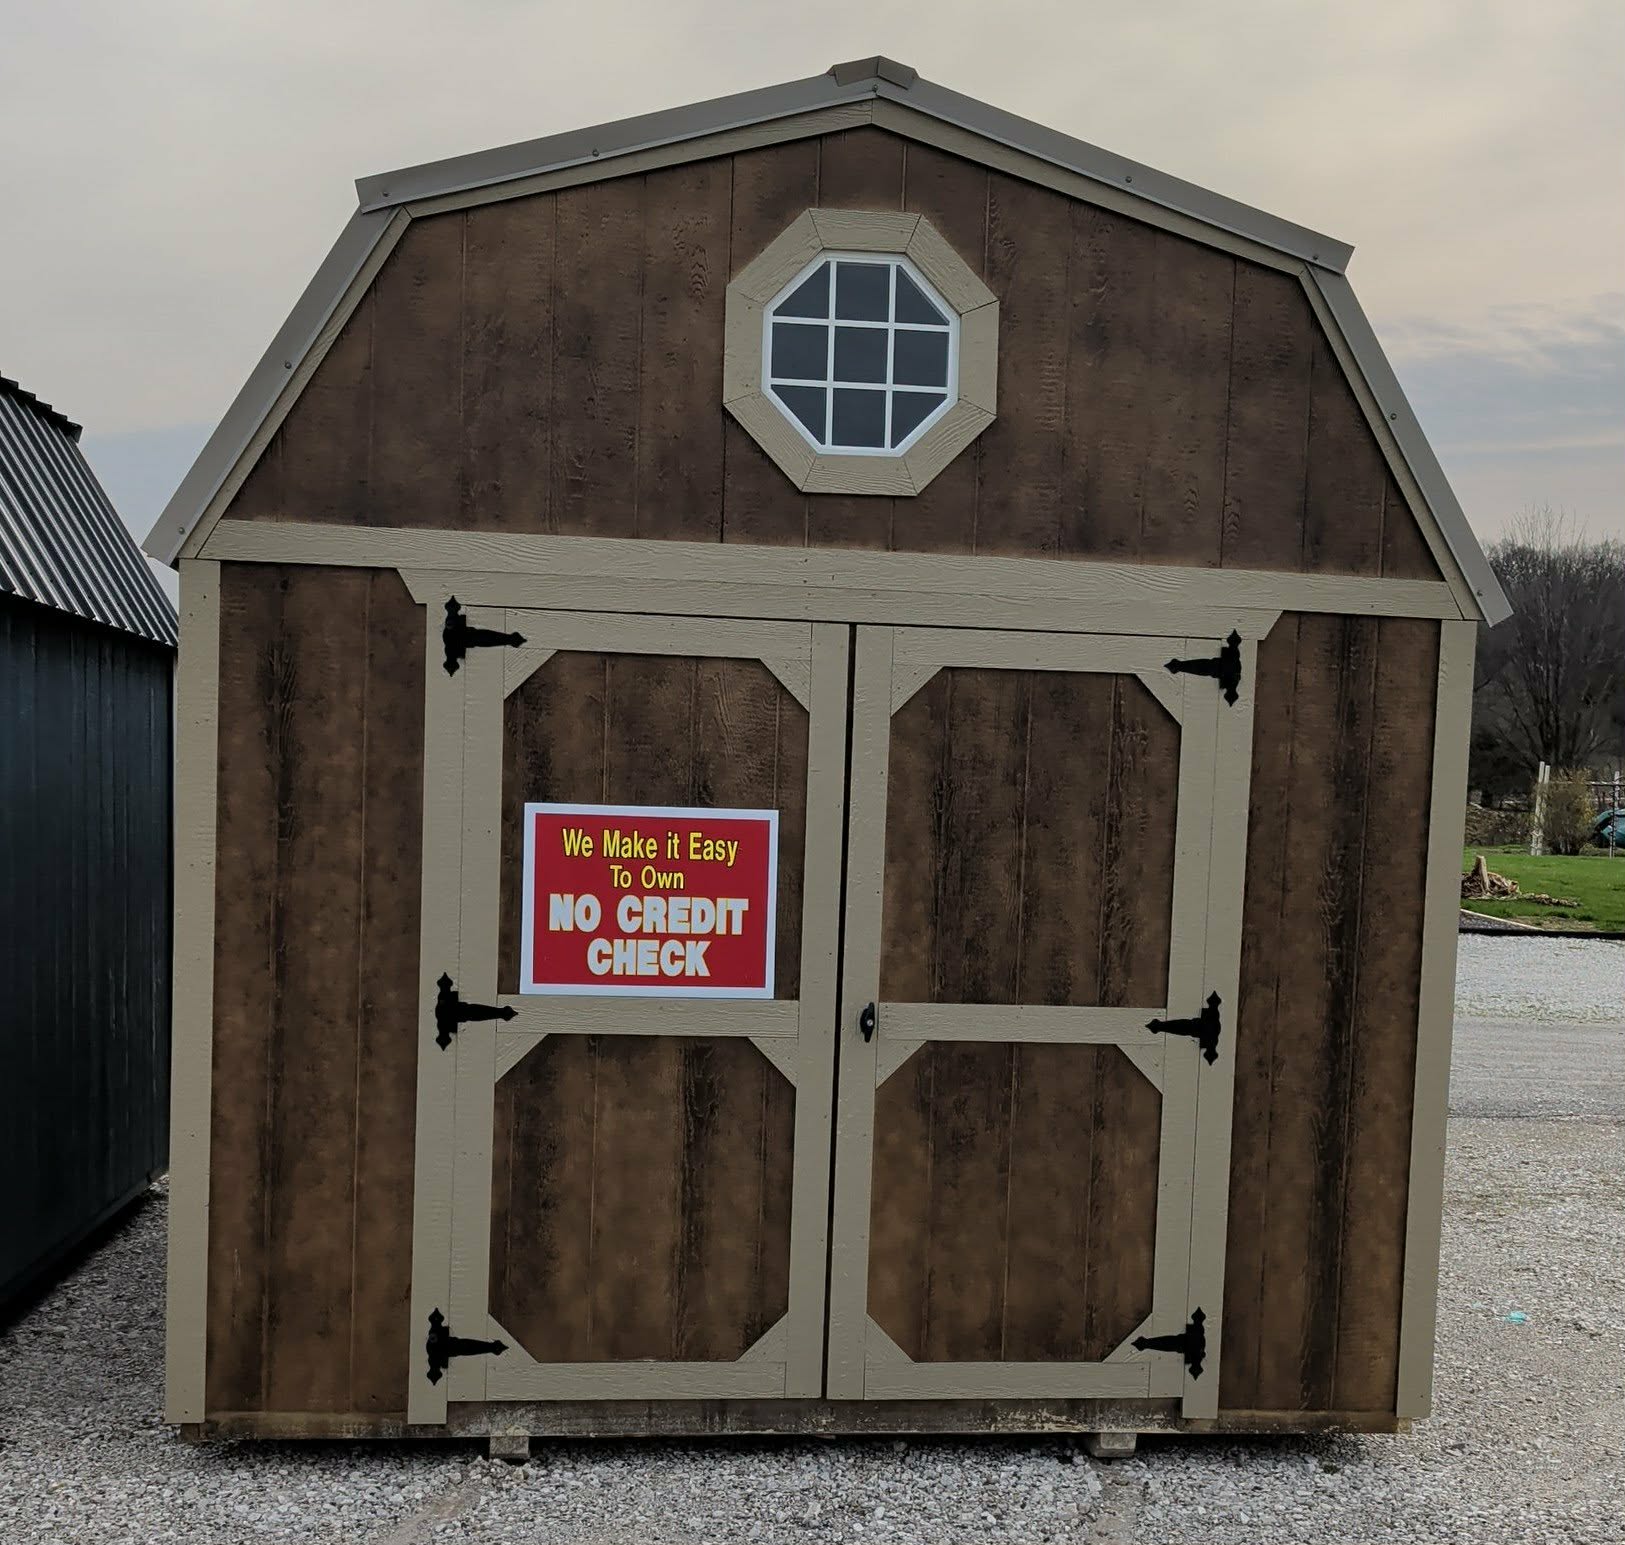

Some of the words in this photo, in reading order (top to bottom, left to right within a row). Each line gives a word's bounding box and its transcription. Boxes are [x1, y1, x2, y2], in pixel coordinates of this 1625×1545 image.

[562, 828, 594, 858] We
[603, 829, 659, 860] Make
[667, 831, 680, 860] it
[689, 832, 739, 867] Easy
[609, 864, 632, 888] To
[641, 865, 684, 890] Own
[548, 893, 602, 933] NO
[616, 894, 749, 936] CREDIT
[587, 937, 711, 977] CHECK
